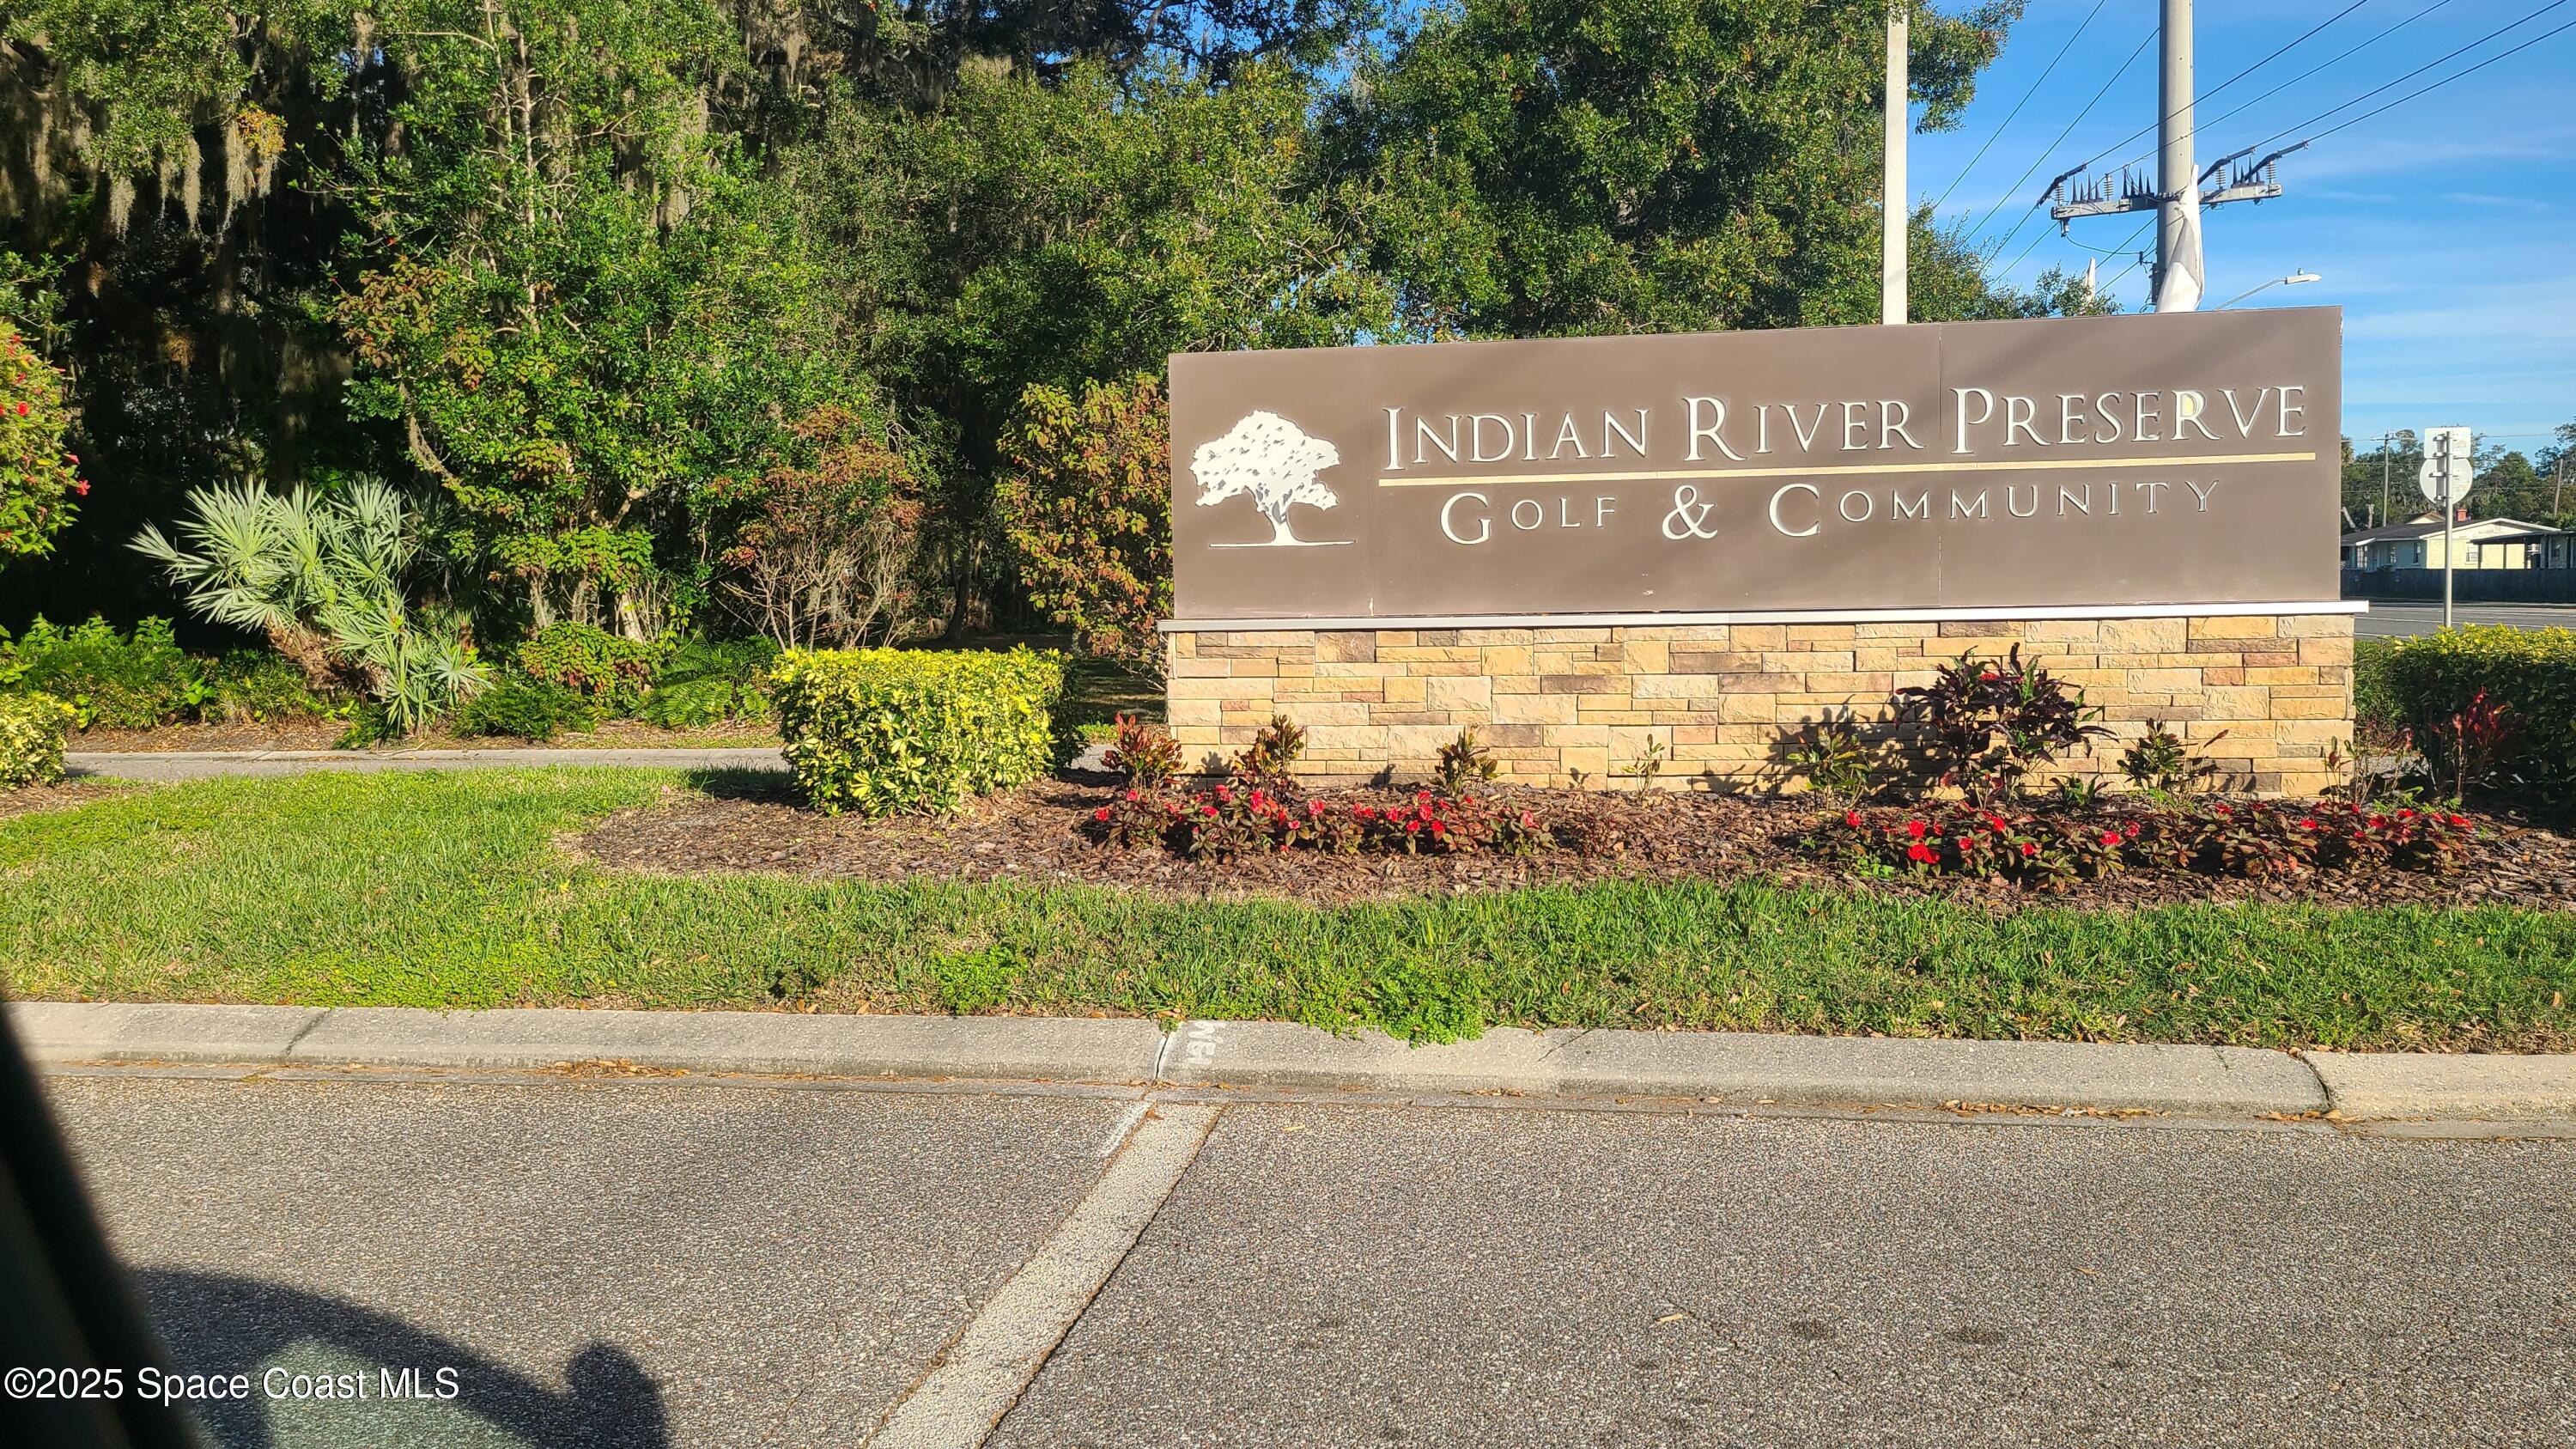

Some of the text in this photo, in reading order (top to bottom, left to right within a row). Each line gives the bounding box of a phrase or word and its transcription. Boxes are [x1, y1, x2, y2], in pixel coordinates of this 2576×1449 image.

[1382, 385, 2307, 472] INDIAN RIVER PRESERVE
[1439, 479, 2220, 545] GOLF & COMMUNITY
